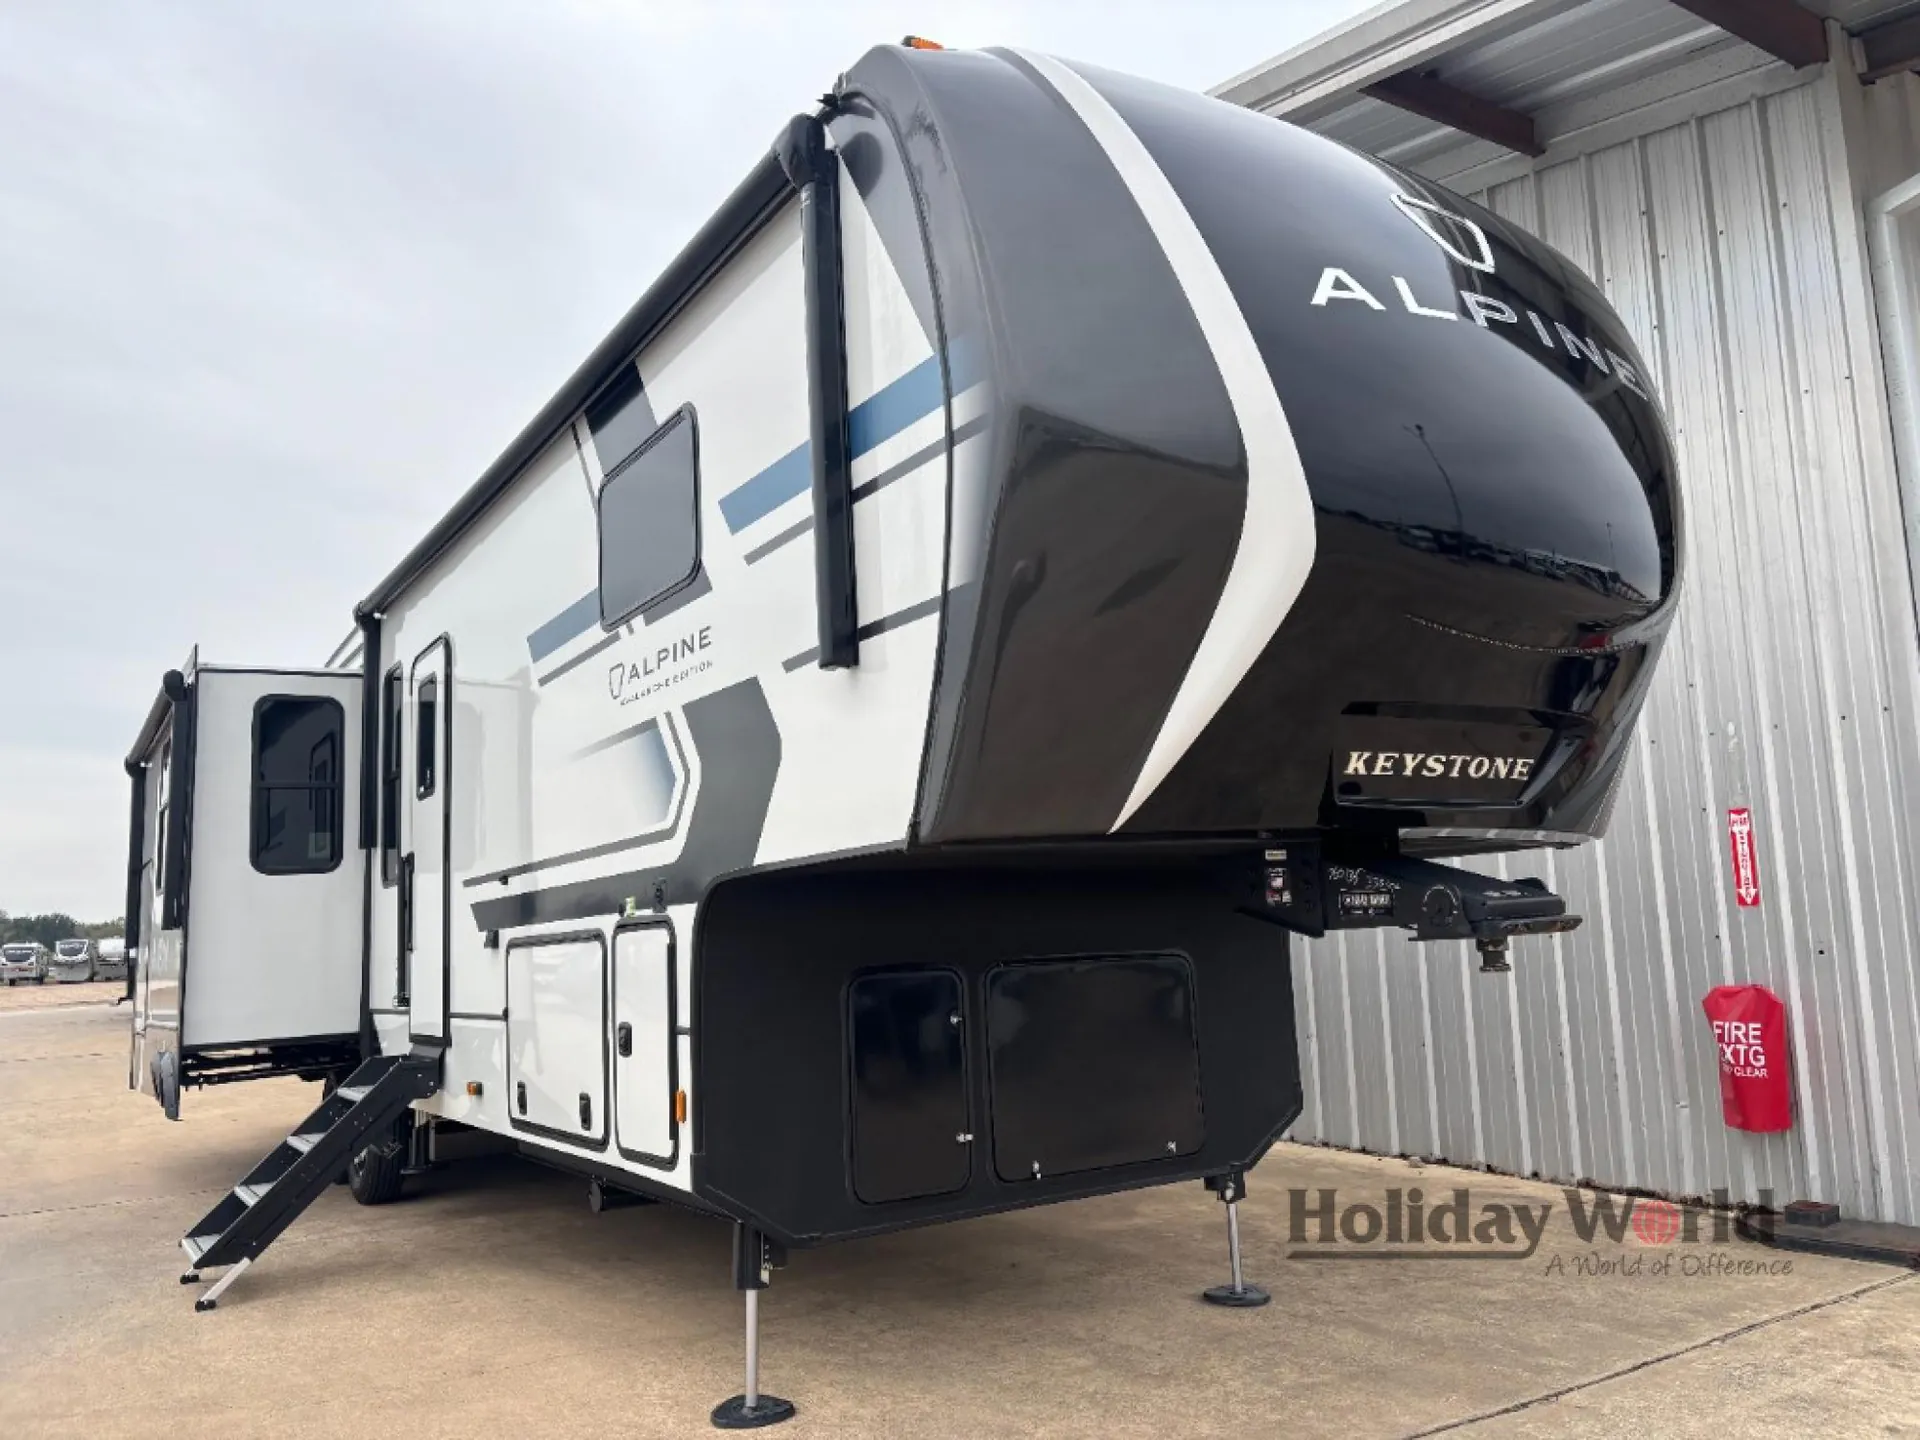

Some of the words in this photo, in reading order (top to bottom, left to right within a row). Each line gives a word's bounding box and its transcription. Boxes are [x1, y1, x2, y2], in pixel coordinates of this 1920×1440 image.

[1310, 267, 1648, 400] ALPINE
[628, 625, 711, 684] ALPINE
[1343, 751, 1535, 780] KEYSTONE
[1713, 1021, 1762, 1044] FIRE
